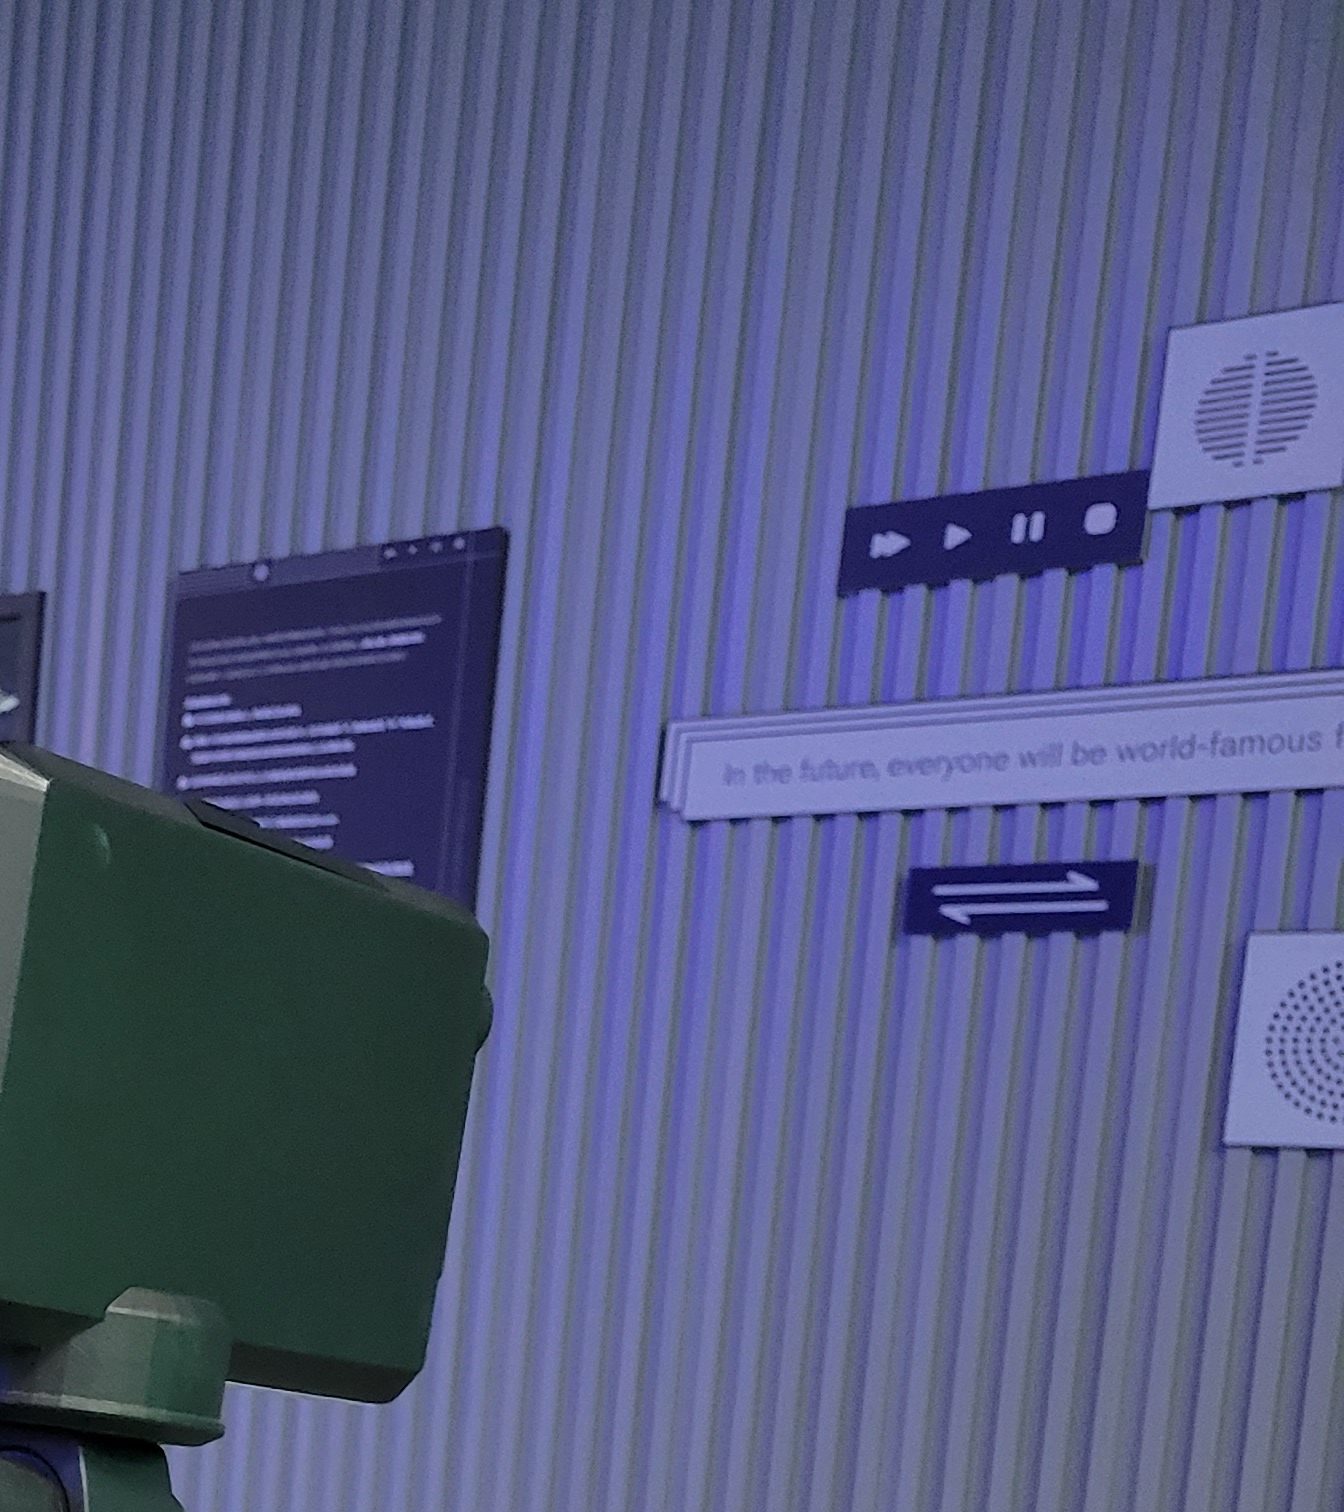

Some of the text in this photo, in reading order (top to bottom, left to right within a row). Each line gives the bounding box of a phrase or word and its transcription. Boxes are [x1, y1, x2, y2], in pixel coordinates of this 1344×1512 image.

[752, 760, 793, 785] the
[887, 751, 1011, 783] everyone
[1019, 742, 1064, 769] will
[1071, 739, 1108, 766] be
[1118, 729, 1323, 763] world-famous
